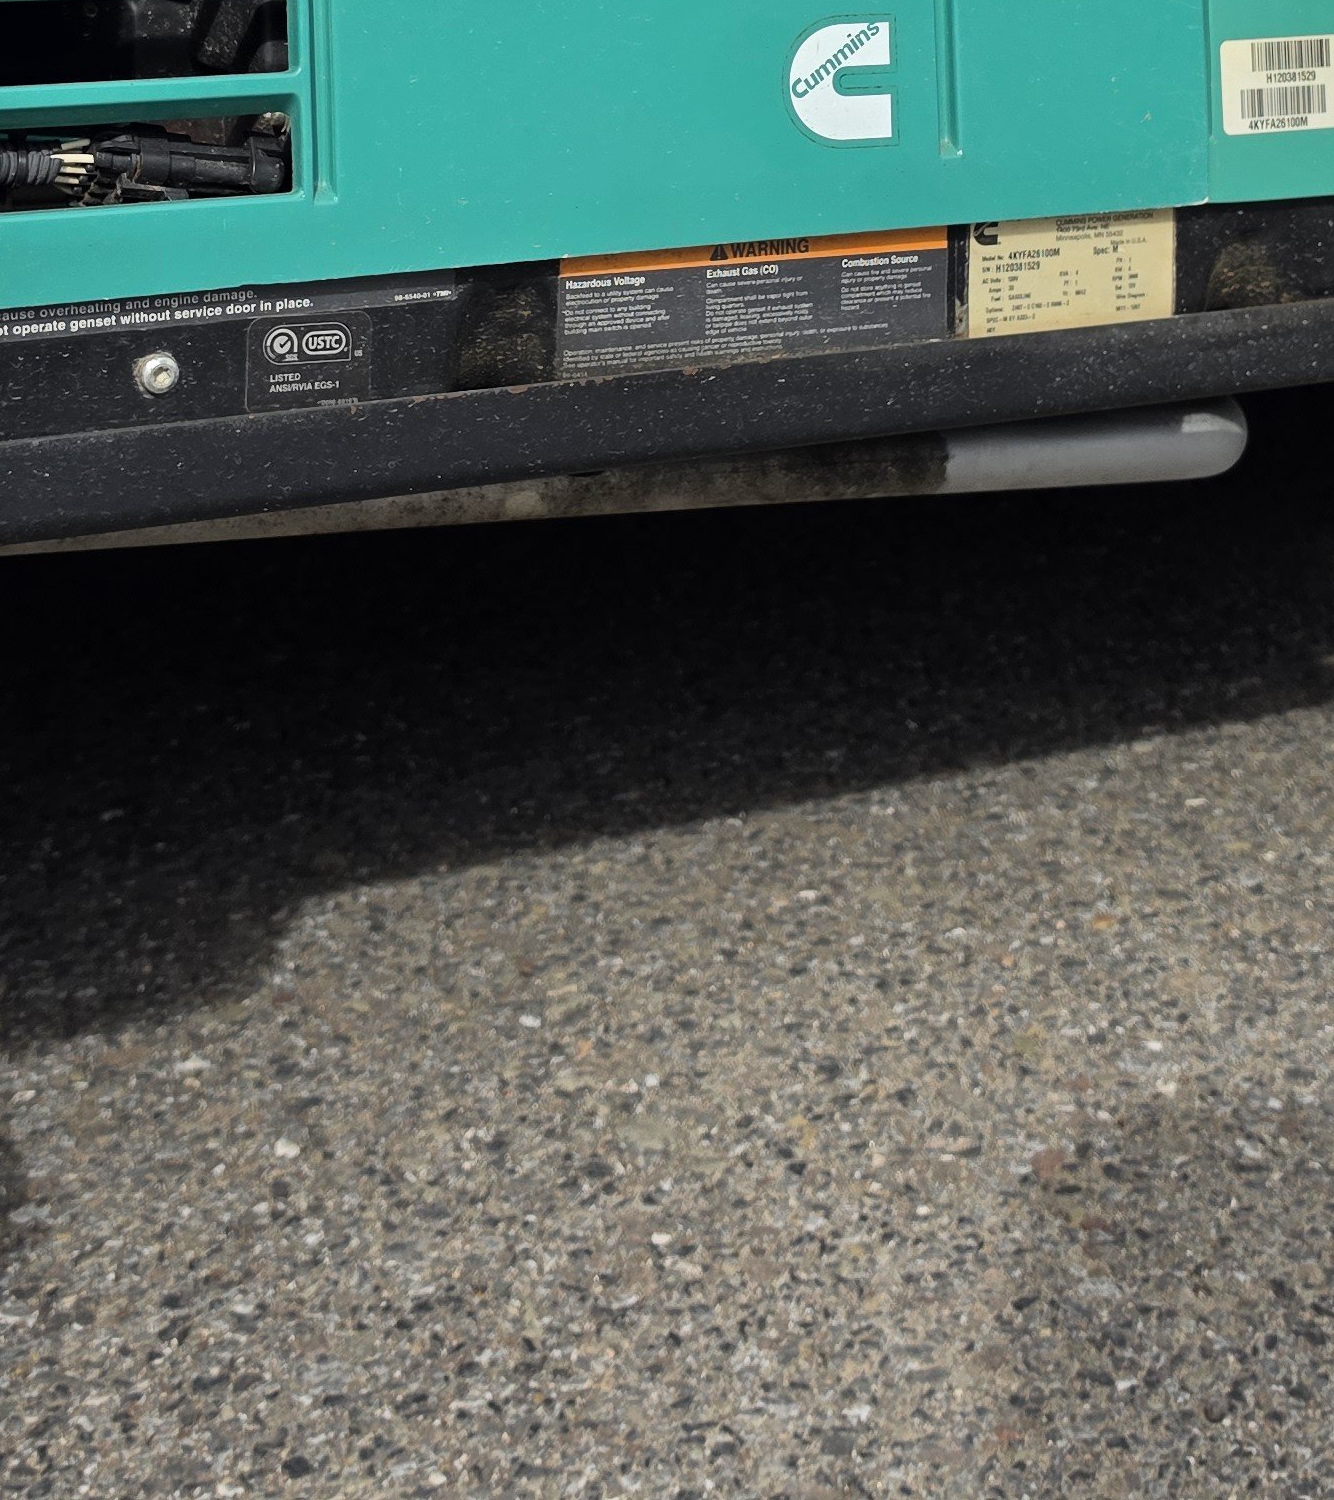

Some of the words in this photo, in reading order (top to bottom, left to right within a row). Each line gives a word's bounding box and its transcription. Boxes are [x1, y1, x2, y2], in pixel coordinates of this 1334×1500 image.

[791, 21, 880, 98] Cummins
[1266, 71, 1317, 84] H120381529
[1248, 116, 1309, 131] 4KYFA26100M
[730, 238, 809, 258] WARNING
[1009, 248, 1060, 261] 4KYFA26100M
[1113, 244, 1118, 253] M
[842, 255, 889, 268] Combustion
[891, 253, 918, 264] Source
[996, 261, 1040, 273] H120381529
[707, 267, 740, 279] Exhaust
[742, 265, 758, 276] Gas
[760, 264, 779, 276] (CO)
[566, 278, 611, 290] Hazardous
[614, 275, 646, 288] Voltage
[39, 301, 121, 317] overheating
[125, 298, 150, 310] and
[154, 294, 199, 308] engine
[203, 290, 258, 304] damage.
[12, 319, 66, 336] operate
[69, 315, 117, 332] genset
[120, 308, 171, 324] without
[174, 305, 222, 319] service
[226, 303, 256, 315] door
[260, 300, 272, 311] in
[276, 298, 314, 312] place.
[308, 335, 340, 350] USTC
[269, 372, 302, 383] LISTED
[269, 382, 312, 393] ANSI/RVIA
[314, 380, 340, 390] EGS-1
